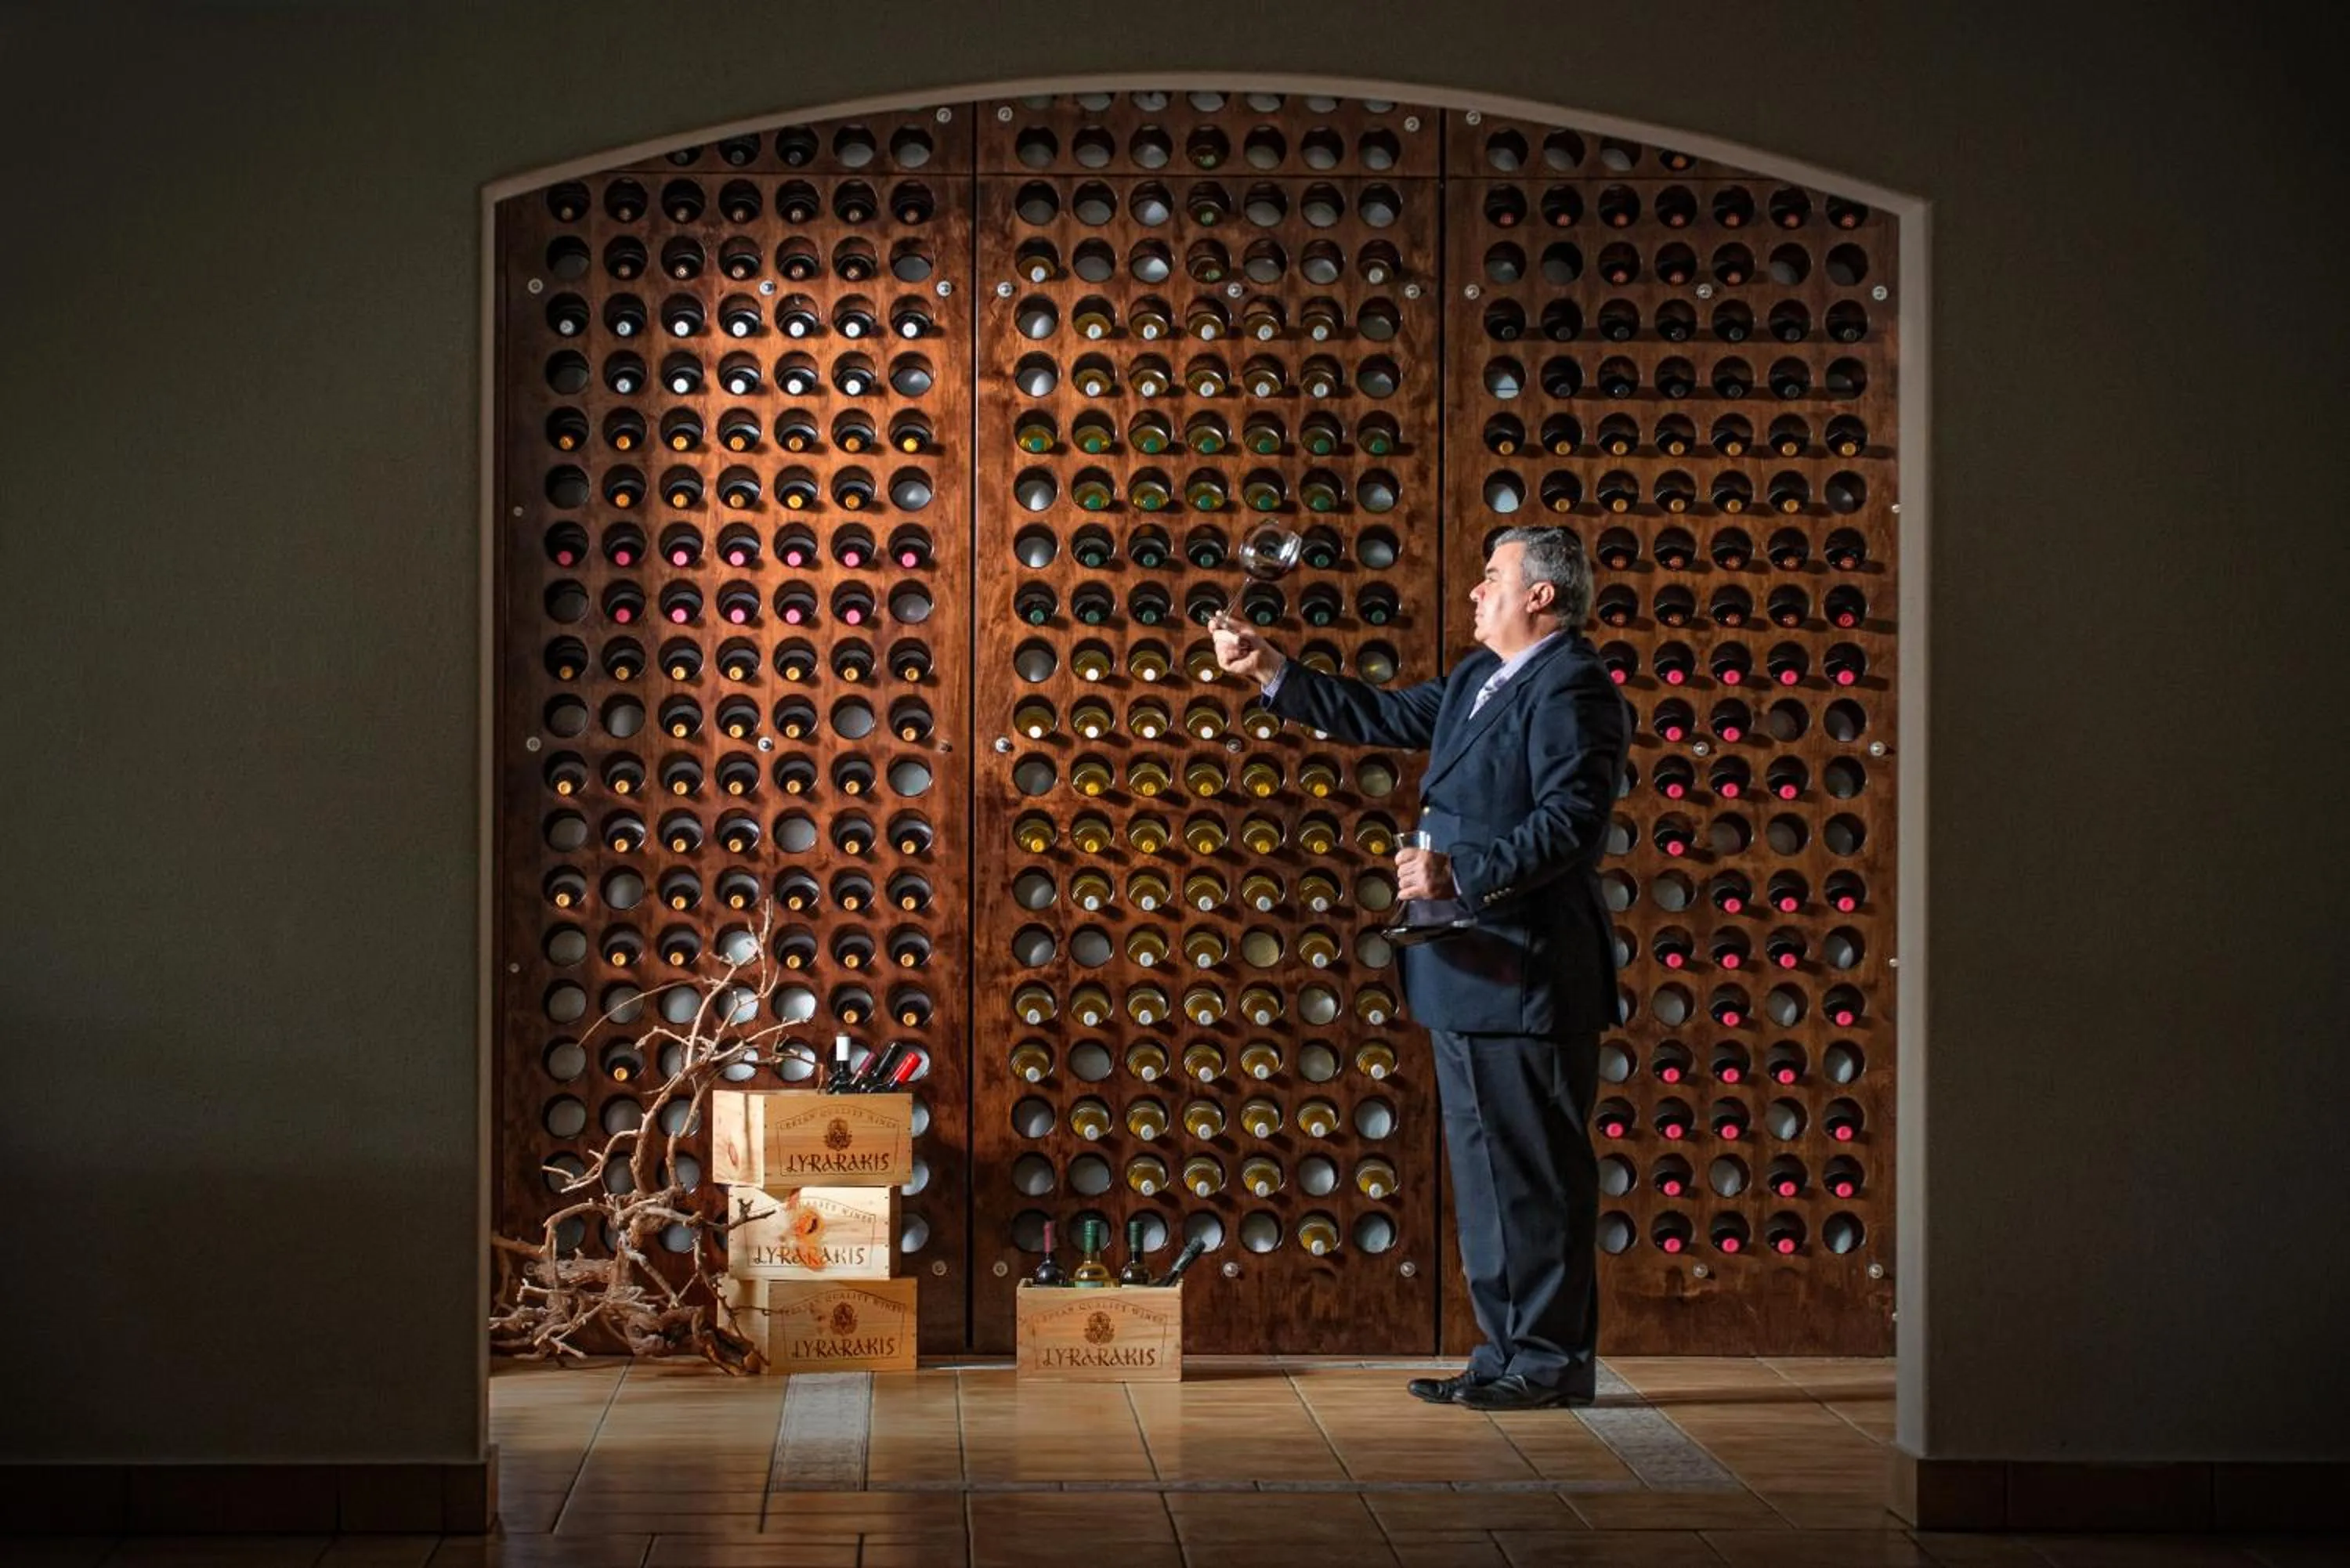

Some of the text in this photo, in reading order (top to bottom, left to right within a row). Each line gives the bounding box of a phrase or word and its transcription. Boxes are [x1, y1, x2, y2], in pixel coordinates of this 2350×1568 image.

[786, 1152, 890, 1172] LYRARAKIS
[753, 1245, 866, 1266] LYRARAKIS
[792, 1337, 896, 1359] LYRARAKIS
[1043, 1347, 1156, 1367] LYRARAKIS
